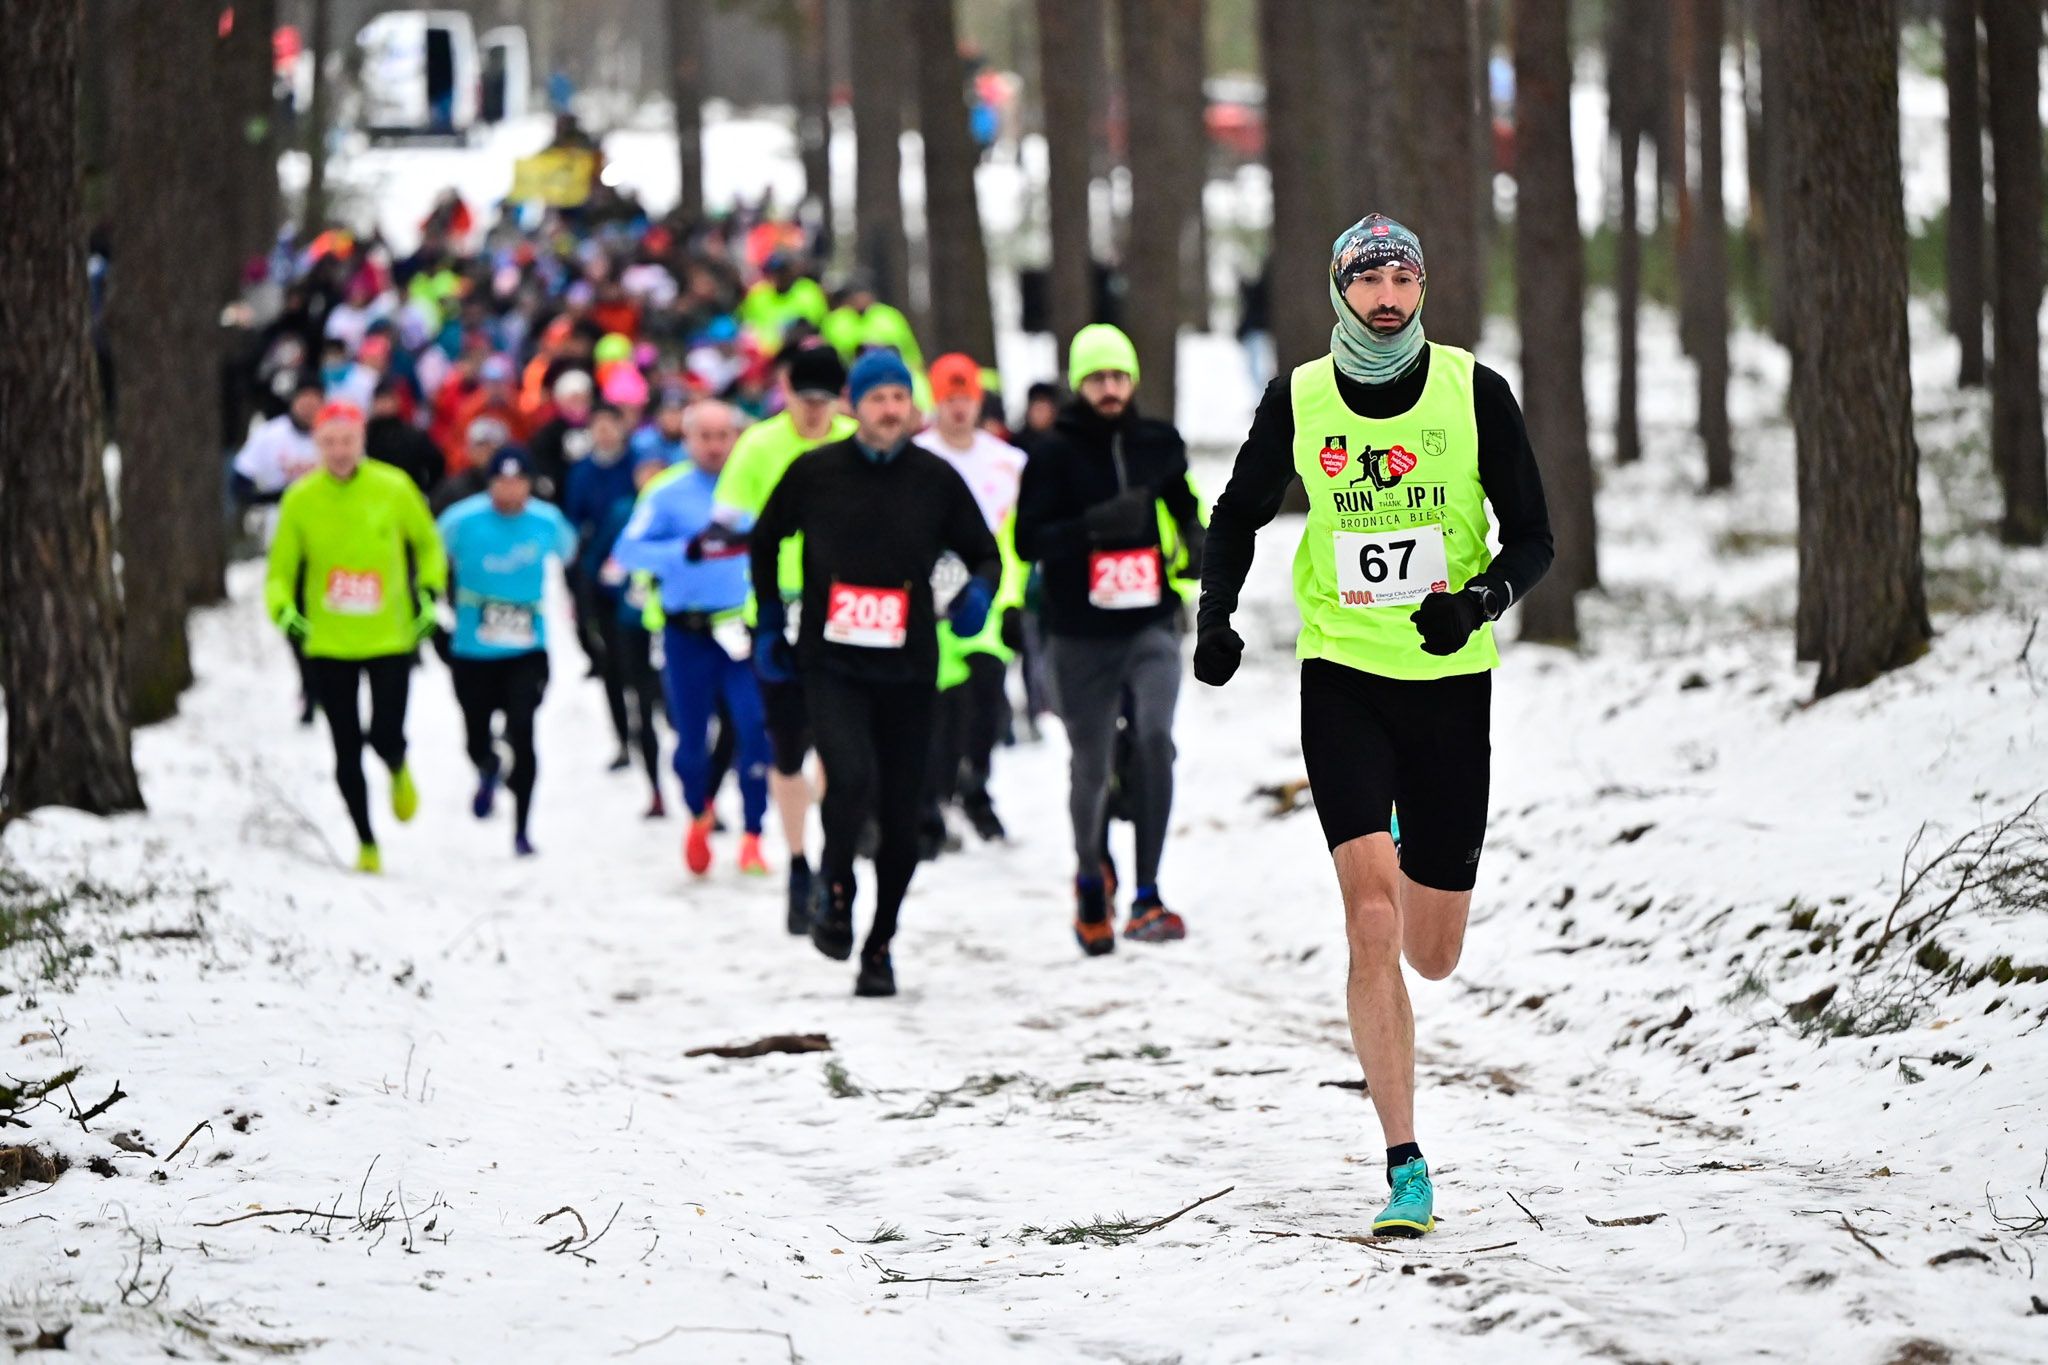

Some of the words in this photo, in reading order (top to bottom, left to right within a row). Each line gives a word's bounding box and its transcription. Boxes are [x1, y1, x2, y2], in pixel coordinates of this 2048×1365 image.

[1333, 491, 1374, 512] RUN
[1407, 487, 1426, 508] JP
[1433, 487, 1446, 506] II
[1341, 514, 1401, 529] BRODNICA
[1095, 555, 1157, 592] 263
[1359, 539, 1416, 583] 67
[832, 591, 902, 629] 208
